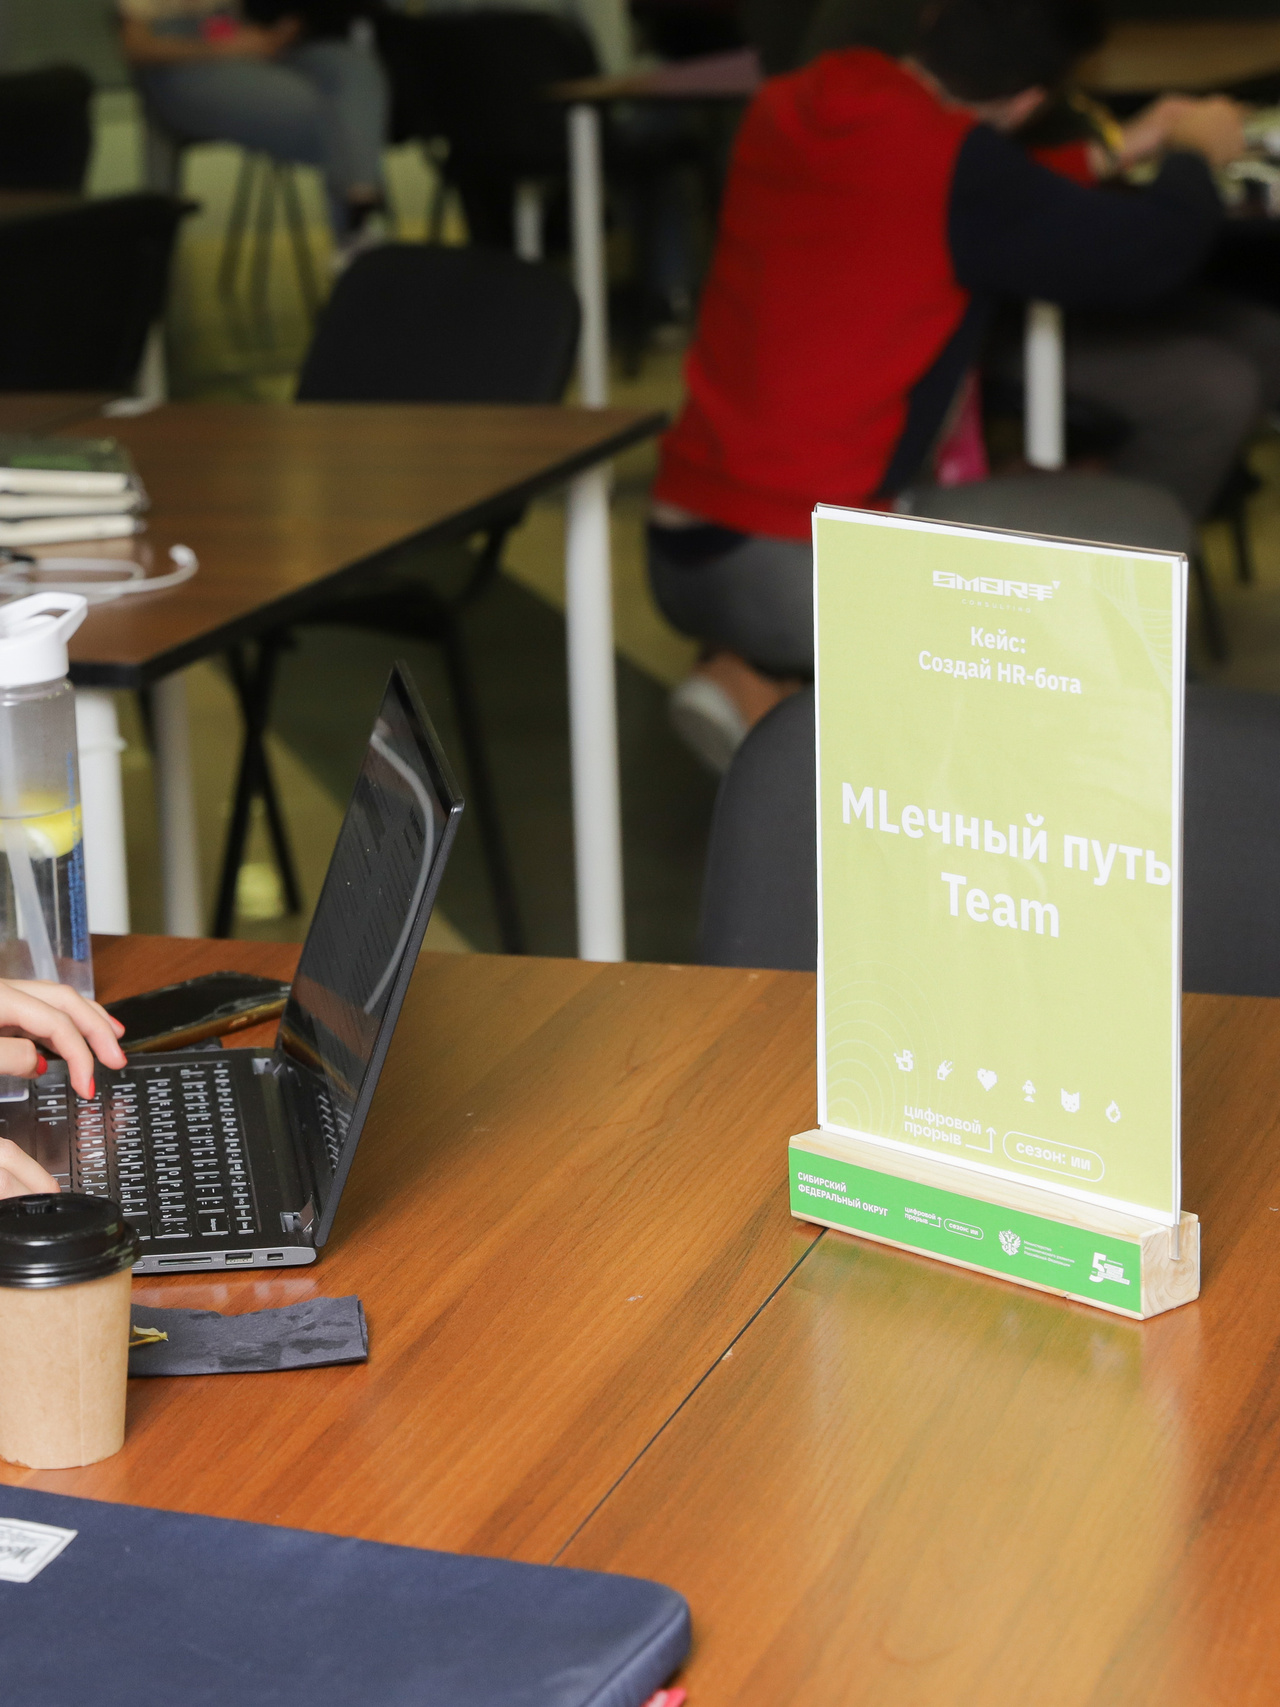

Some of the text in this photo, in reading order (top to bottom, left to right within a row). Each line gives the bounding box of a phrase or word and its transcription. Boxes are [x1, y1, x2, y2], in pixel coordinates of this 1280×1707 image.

[932, 570, 1053, 601] SMART
[970, 626, 1027, 654] Кейс:
[918, 650, 1083, 694] Создай HR-бота
[841, 781, 1172, 887] MLечный путь
[941, 871, 1061, 939] Team
[903, 1104, 982, 1135] цифровой
[903, 1121, 962, 1146] прорыв
[1015, 1142, 1067, 1165] сезон:
[797, 1171, 847, 1193] СИБИРСКИЙ
[798, 1183, 889, 1217] ФЕДЕРАЛЬНЫЙ ОКРУГ
